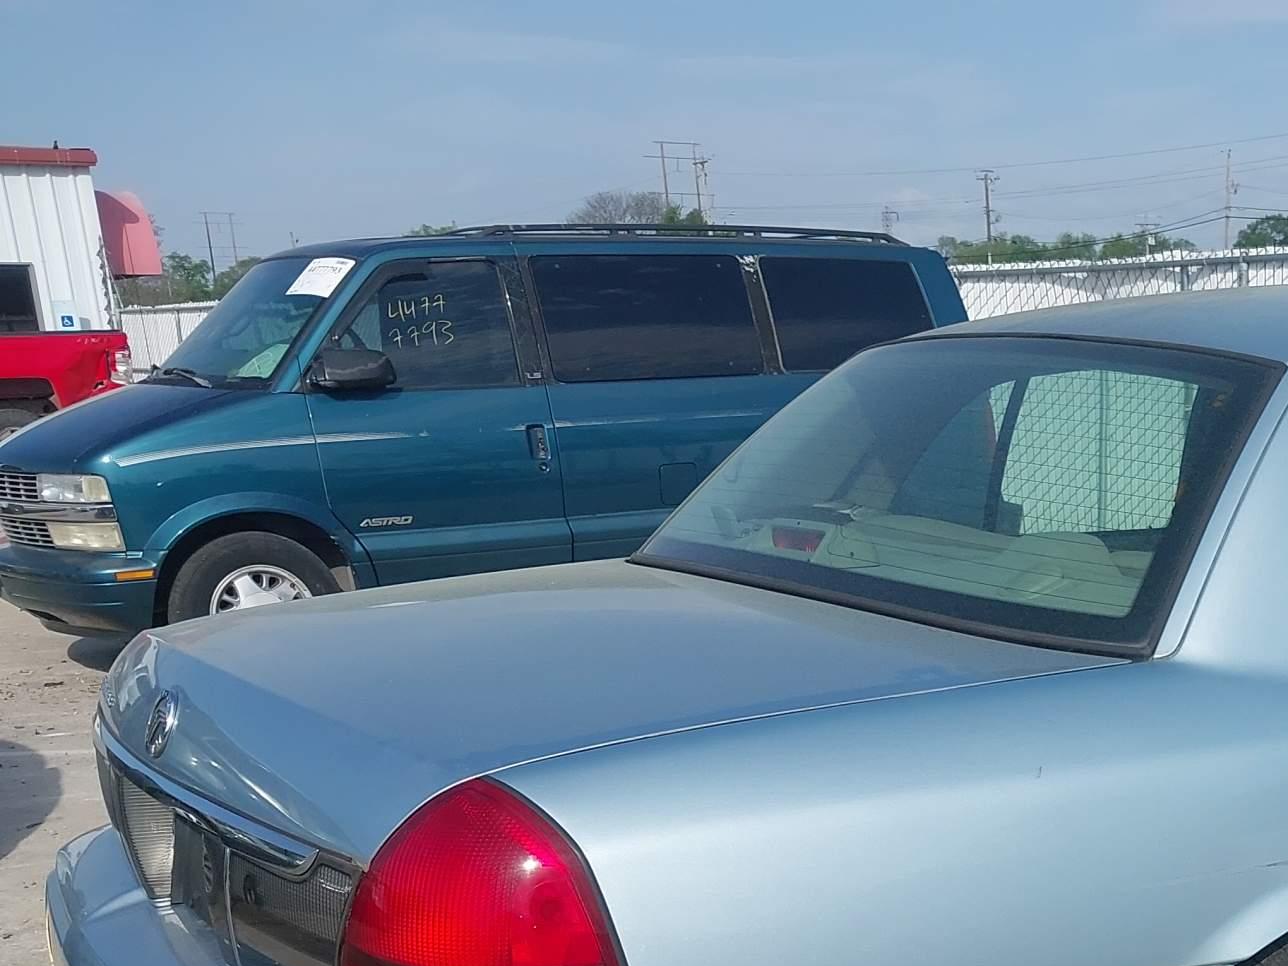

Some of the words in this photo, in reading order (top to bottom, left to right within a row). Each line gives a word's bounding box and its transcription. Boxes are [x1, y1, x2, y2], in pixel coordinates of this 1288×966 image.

[388, 294, 446, 322] 4477
[388, 320, 454, 349] 7793
[359, 515, 413, 528] ASTRO
